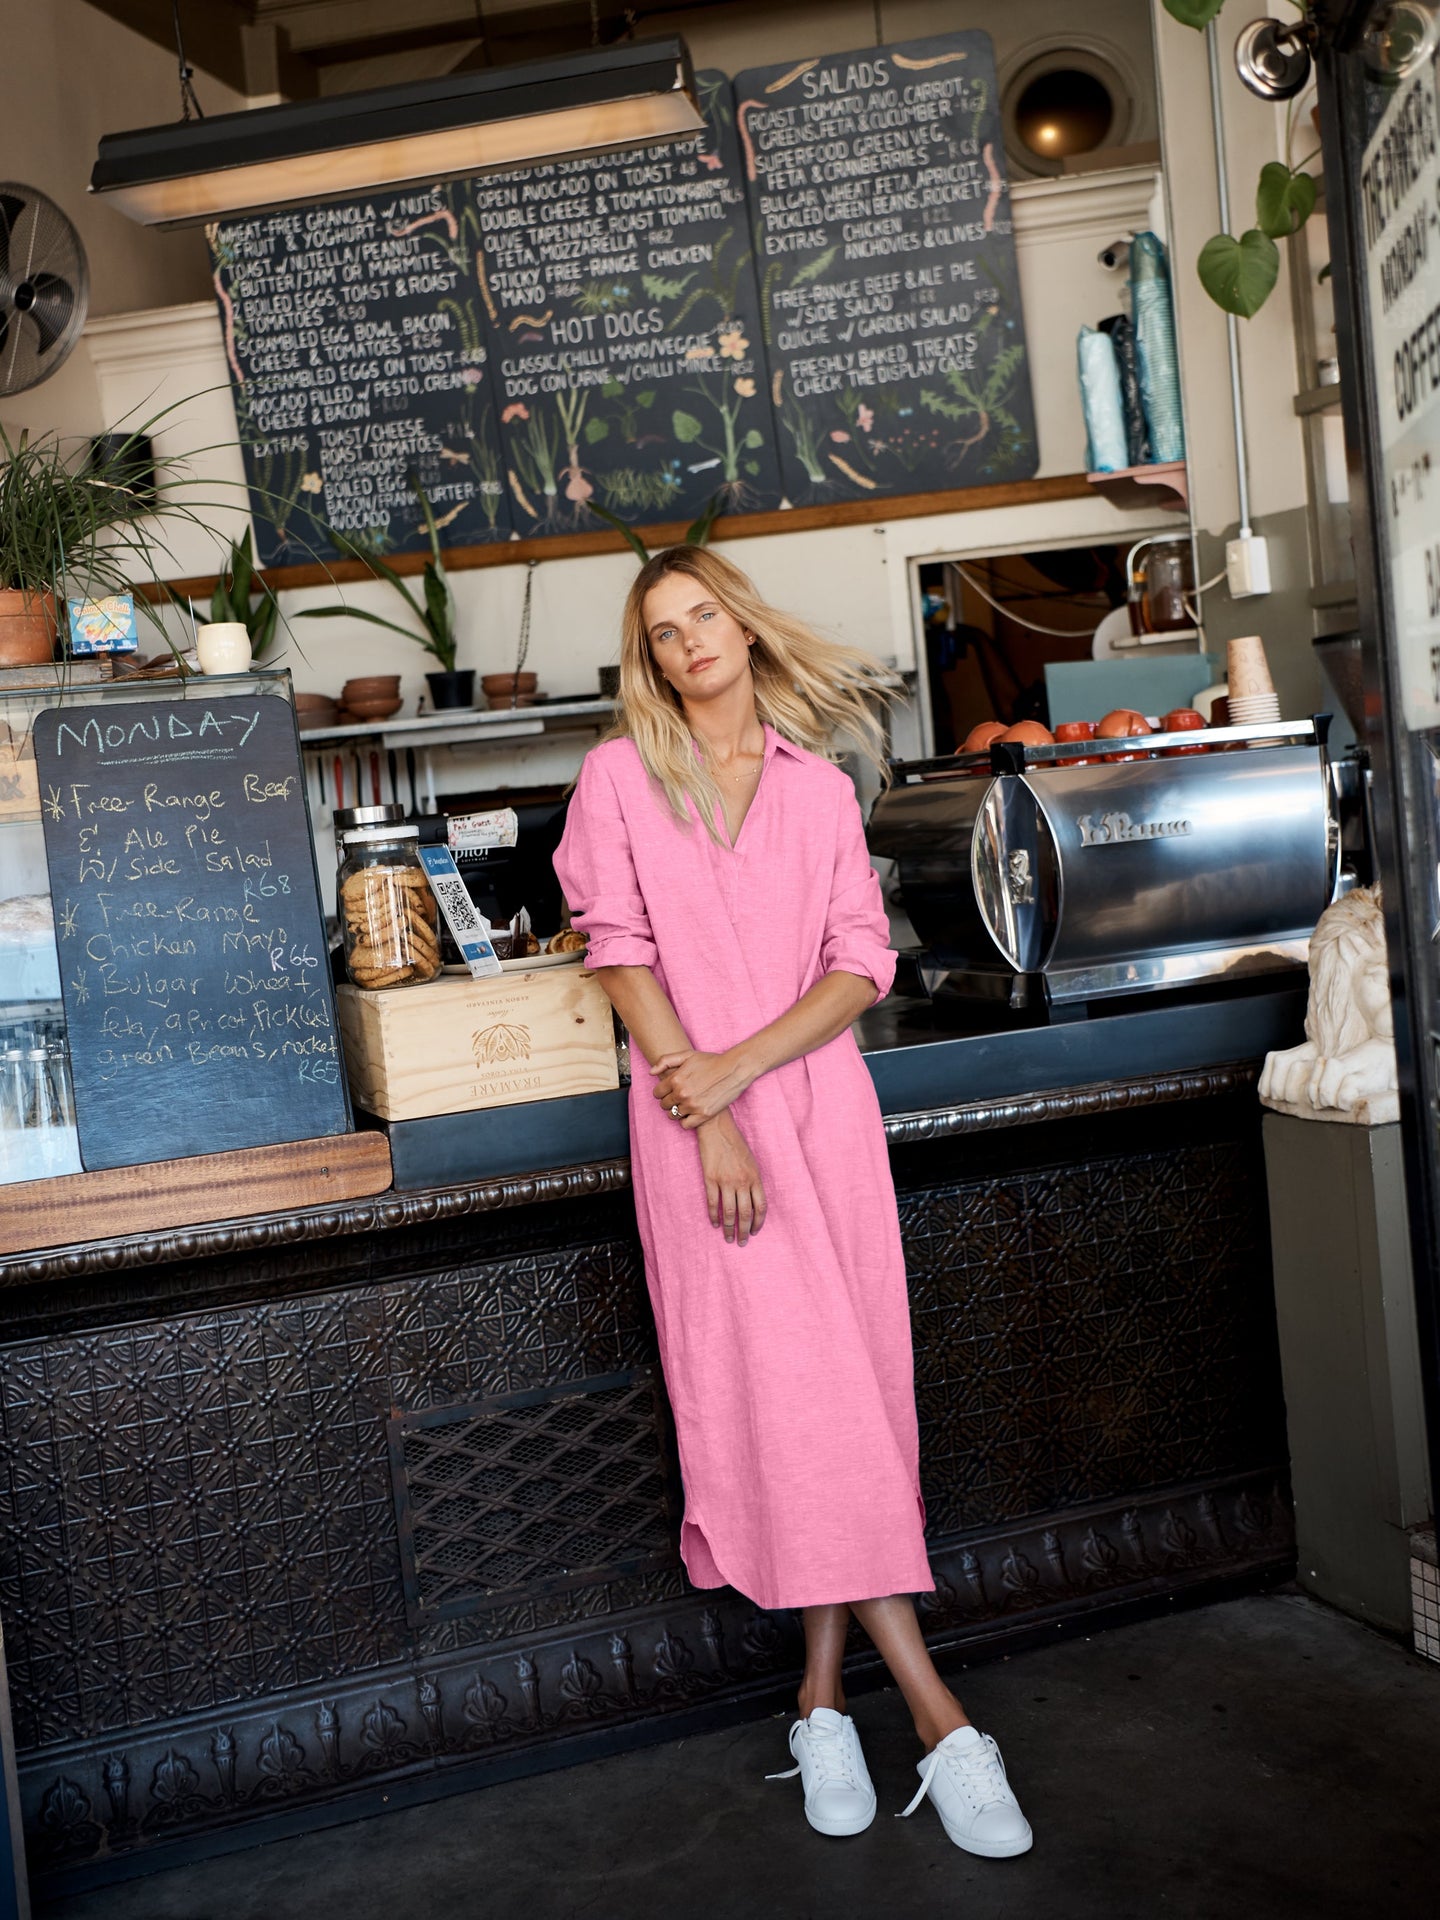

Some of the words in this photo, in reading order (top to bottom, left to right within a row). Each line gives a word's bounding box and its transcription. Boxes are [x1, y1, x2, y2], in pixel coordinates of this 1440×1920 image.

[802, 59, 890, 99] SALADS
[747, 106, 798, 133] ROAST
[820, 117, 856, 138] FETA
[675, 135, 707, 156] RYE
[755, 141, 849, 174] SUPERFOOD
[853, 130, 909, 157] GREEN
[767, 168, 807, 191] FETA
[811, 164, 823, 184] &
[823, 146, 930, 181] CRANBERRIES
[477, 185, 518, 210] OPEN
[521, 175, 591, 203] AVOCADO
[594, 172, 619, 192] ON
[760, 188, 818, 215] BULGAR
[218, 215, 302, 243] WHEAT-FREE
[305, 204, 377, 231] GRANOLA
[480, 204, 537, 232] DOUBLE
[540, 197, 592, 223] CHEESE
[595, 194, 609, 215] &
[766, 205, 824, 232] PICKLED
[824, 197, 872, 222] GREEN
[233, 238, 275, 260] FRUIT
[285, 232, 299, 252] &
[484, 229, 524, 253] OLIVE
[526, 217, 605, 246] TAPENADE
[608, 209, 655, 234] ROAST
[540, 231, 639, 262] MOZZARELLA
[765, 228, 829, 255] EXTRAS
[842, 216, 903, 242] CHICKEN
[844, 230, 921, 260] ANCHOVIES
[226, 258, 272, 280] TOAST
[240, 267, 336, 297] BUTTER/JAM
[342, 263, 363, 282] OR
[489, 267, 541, 292] STICKY
[545, 252, 641, 283] FREE-RANGE
[648, 243, 713, 269] CHICKEN
[243, 294, 292, 319] BOILED
[340, 280, 389, 304] TOAST
[501, 284, 546, 308] MAYO
[772, 279, 860, 310] FREE-RANGE
[864, 271, 901, 296] BEEF
[904, 270, 917, 289] &
[917, 265, 945, 287] ALE
[950, 260, 978, 282] PIE
[246, 308, 324, 335] TOMATOES
[804, 301, 839, 324] SIDE
[844, 292, 894, 318] SALAD
[238, 329, 319, 358] SCRAMBLED
[320, 325, 350, 346] EGG
[550, 314, 598, 345] HOT
[604, 307, 665, 339] DOGS
[778, 324, 831, 351] QUICHE
[858, 312, 917, 338] GARDEN
[920, 302, 972, 328] SALAD
[250, 351, 301, 374] CHEESE
[309, 348, 323, 367] &
[324, 338, 402, 362] TOMATOES
[501, 347, 605, 377] CLASSIC/CHILLI
[790, 352, 855, 379] FRESHLY
[858, 343, 908, 368] BAKED
[912, 332, 979, 358] TREATS
[257, 366, 337, 394] SCRAMBLED
[339, 360, 380, 382] EGGS
[384, 358, 406, 377] ON
[505, 376, 539, 398] DOG
[540, 373, 568, 393] CON
[568, 367, 611, 389] CARNE
[677, 354, 722, 375] MINCE
[793, 373, 844, 397] CHECK
[846, 367, 876, 387] THE
[877, 358, 937, 383] DISPLAY
[938, 352, 977, 373] CASE
[249, 391, 308, 417] AVOCADO
[309, 384, 354, 406] FILLED
[258, 411, 307, 433] CHEESE
[311, 407, 322, 426] &
[324, 402, 371, 423] BACON
[317, 418, 428, 448] TOAST/CHEESE
[253, 433, 310, 458] EXTRAS
[320, 444, 364, 465] ROAST
[369, 436, 444, 459] TOMATOES
[322, 457, 408, 481] MUSHROOMS
[324, 478, 373, 501] BOILED
[376, 475, 407, 494] EGG
[329, 510, 391, 530] AVOCADO
[57, 711, 260, 756] MONDAY
[243, 774, 297, 801] Beef
[125, 828, 168, 853] Ale
[125, 856, 181, 881] Side
[206, 840, 273, 873] Salad
[244, 872, 291, 901] R68
[86, 932, 196, 961] Chicken
[224, 927, 288, 954] Mayo
[270, 944, 318, 971] R66
[98, 964, 203, 1008] Bulgar
[466, 999, 504, 1008] VINEYARD
[300, 1059, 339, 1084] R65
[470, 1076, 541, 1097] BRAMARE
